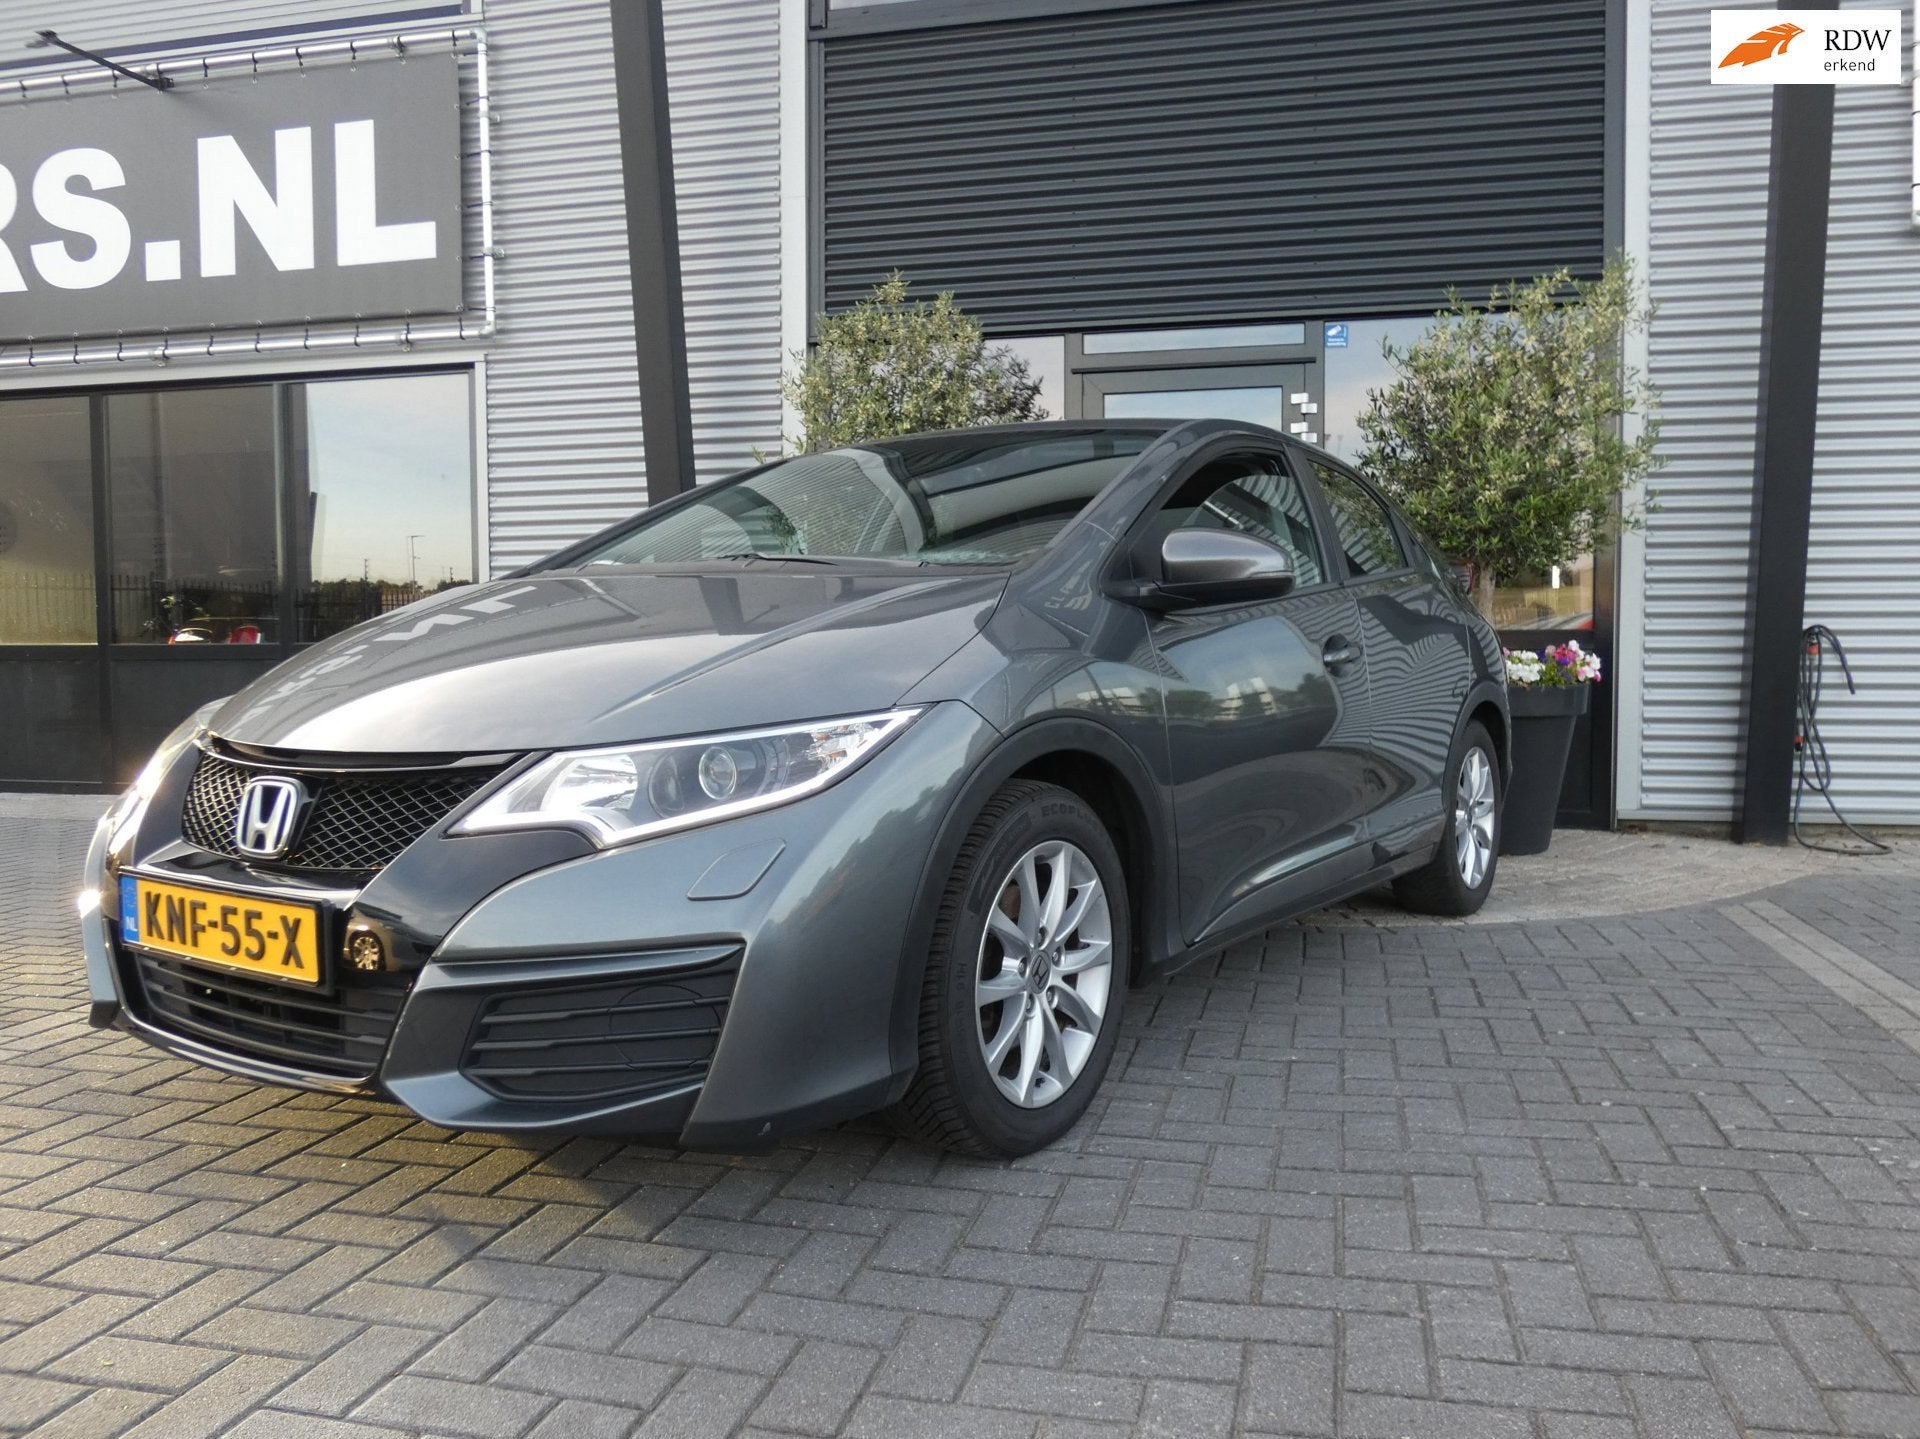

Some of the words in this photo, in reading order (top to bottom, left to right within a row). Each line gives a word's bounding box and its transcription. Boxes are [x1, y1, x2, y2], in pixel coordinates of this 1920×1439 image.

[0, 119, 437, 293] S.NL
[125, 915, 138, 932] NL
[144, 891, 305, 970] KNF-55-X
